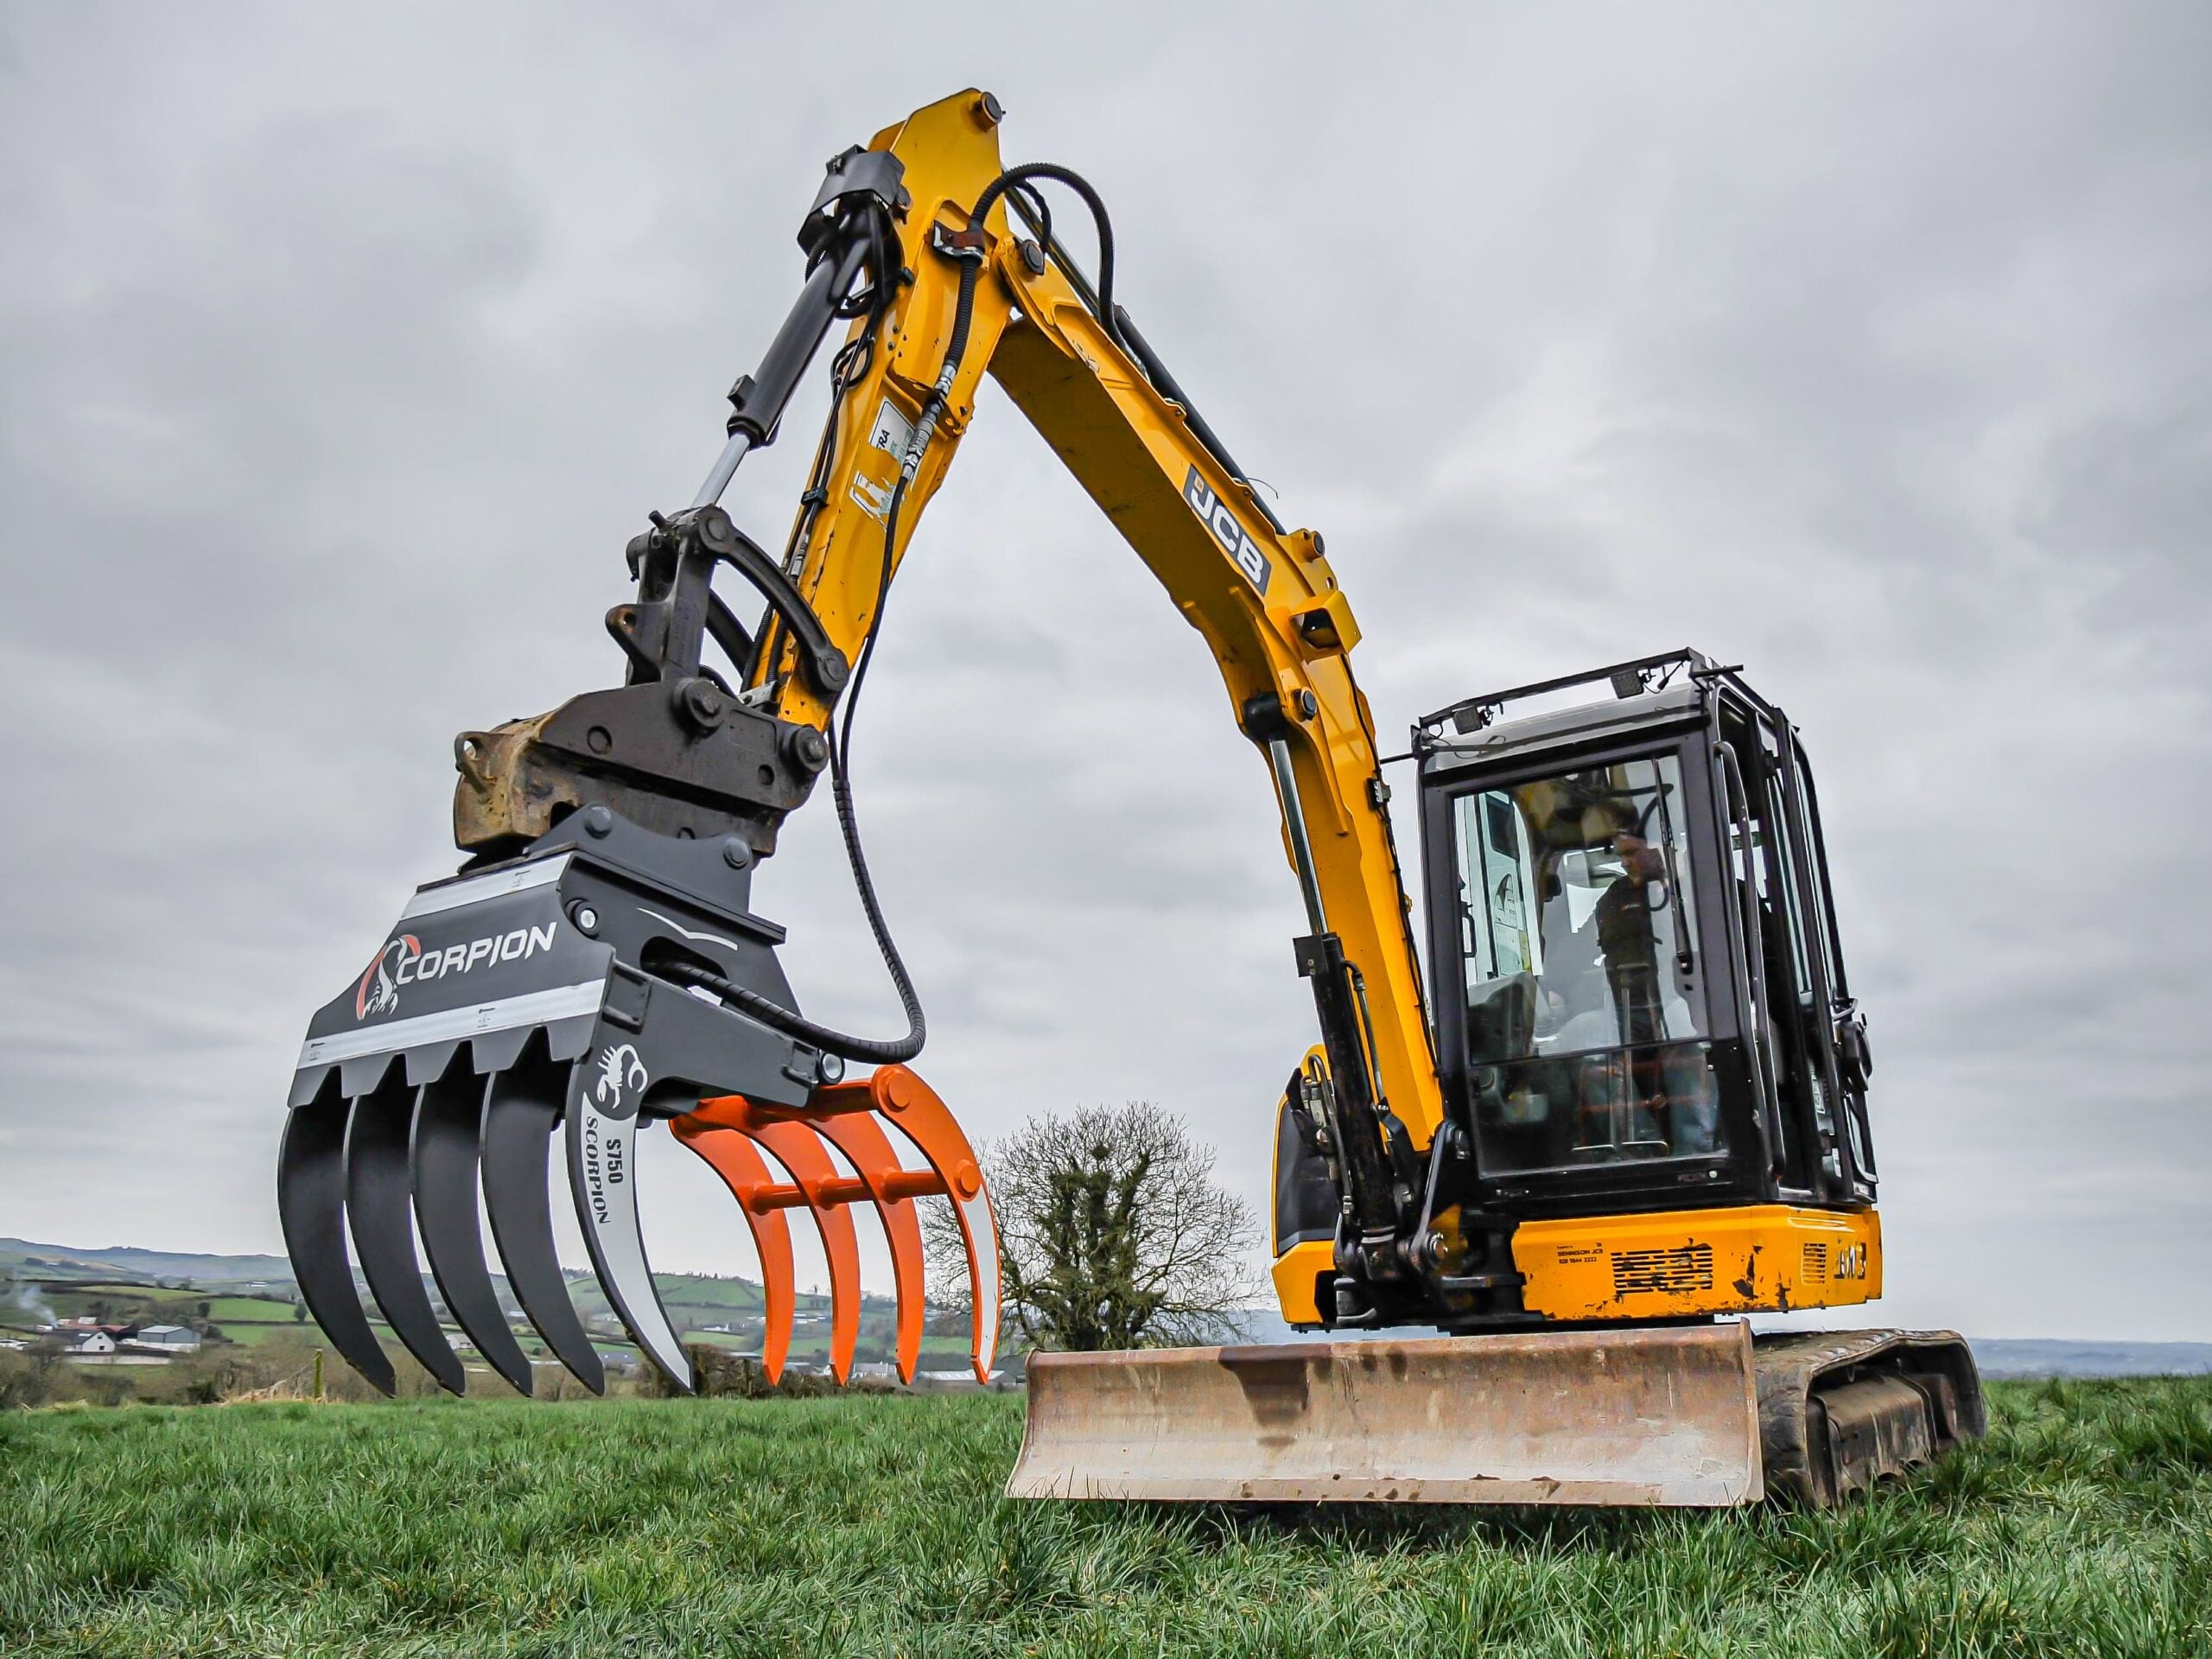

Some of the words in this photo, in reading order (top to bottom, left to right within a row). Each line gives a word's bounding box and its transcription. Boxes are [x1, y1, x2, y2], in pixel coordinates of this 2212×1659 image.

[1191, 488, 1263, 584] JCB
[585, 1116, 612, 1224] SCORPION
[606, 1138, 624, 1184] S750
